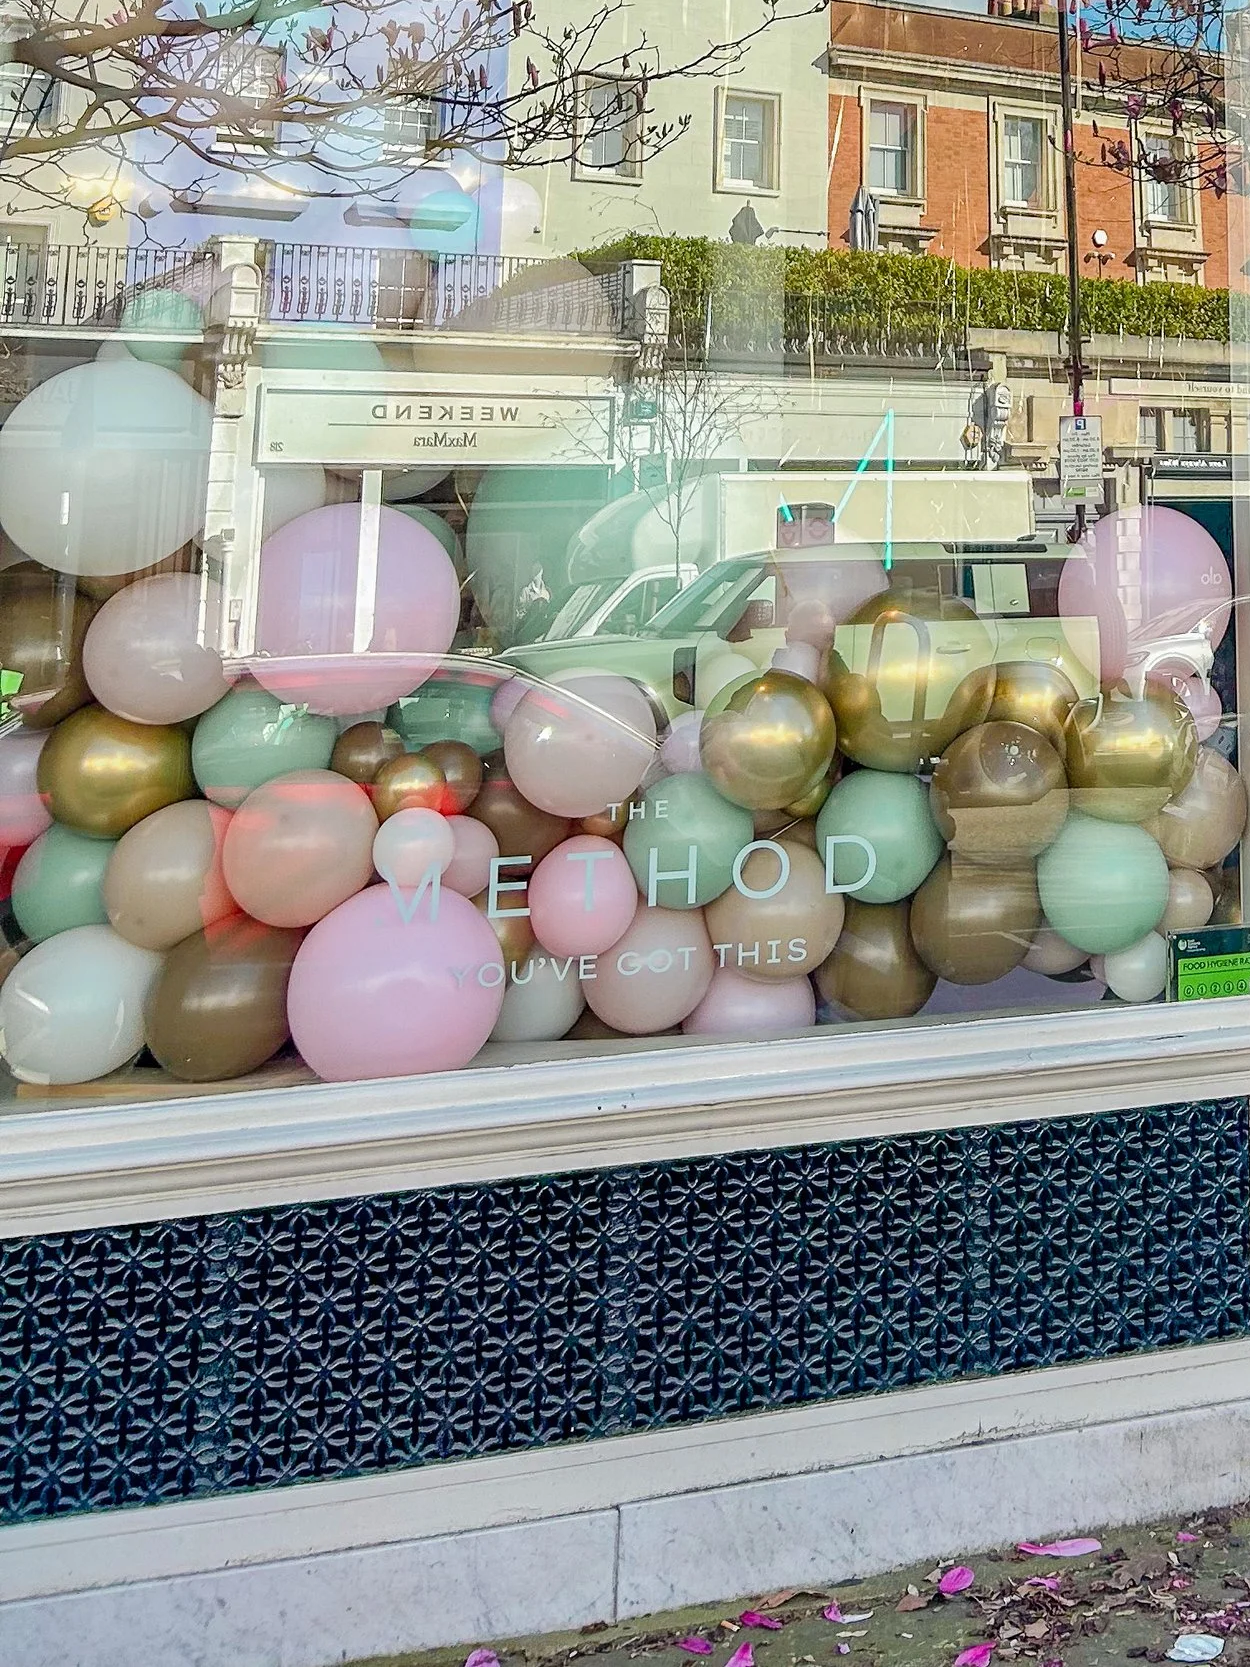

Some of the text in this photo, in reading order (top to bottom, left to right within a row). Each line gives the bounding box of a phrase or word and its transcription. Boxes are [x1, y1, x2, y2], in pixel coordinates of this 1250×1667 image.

[606, 799, 669, 822] THE
[376, 834, 877, 925] METHOD
[447, 937, 808, 988] YOU'VE GOT THIS
[1182, 961, 1206, 971] FOOD
[1206, 958, 1239, 969] HYGIENE
